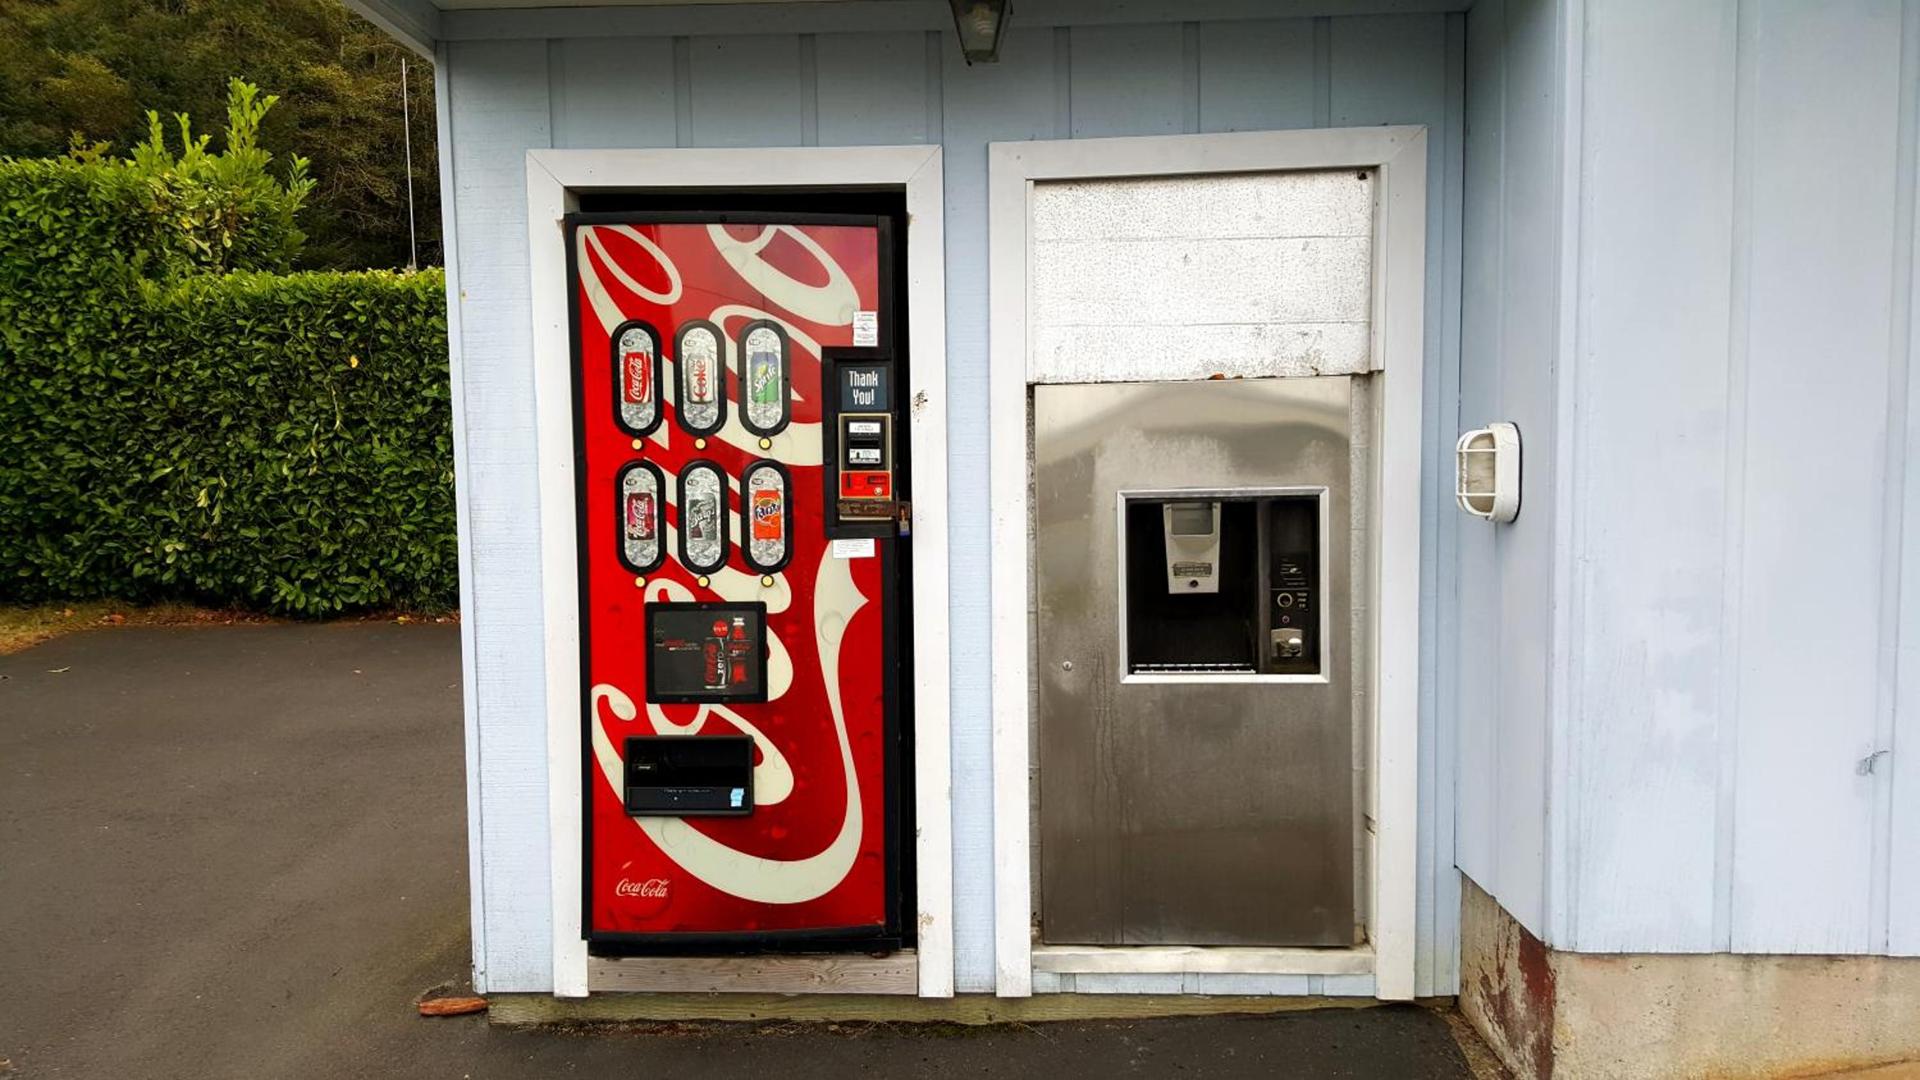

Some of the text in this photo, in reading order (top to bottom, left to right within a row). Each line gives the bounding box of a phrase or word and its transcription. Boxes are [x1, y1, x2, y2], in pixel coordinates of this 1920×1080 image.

[693, 360, 707, 397] Coke
[754, 365, 776, 392] Sprite
[848, 370, 878, 387] Thank
[853, 389, 875, 405] You!
